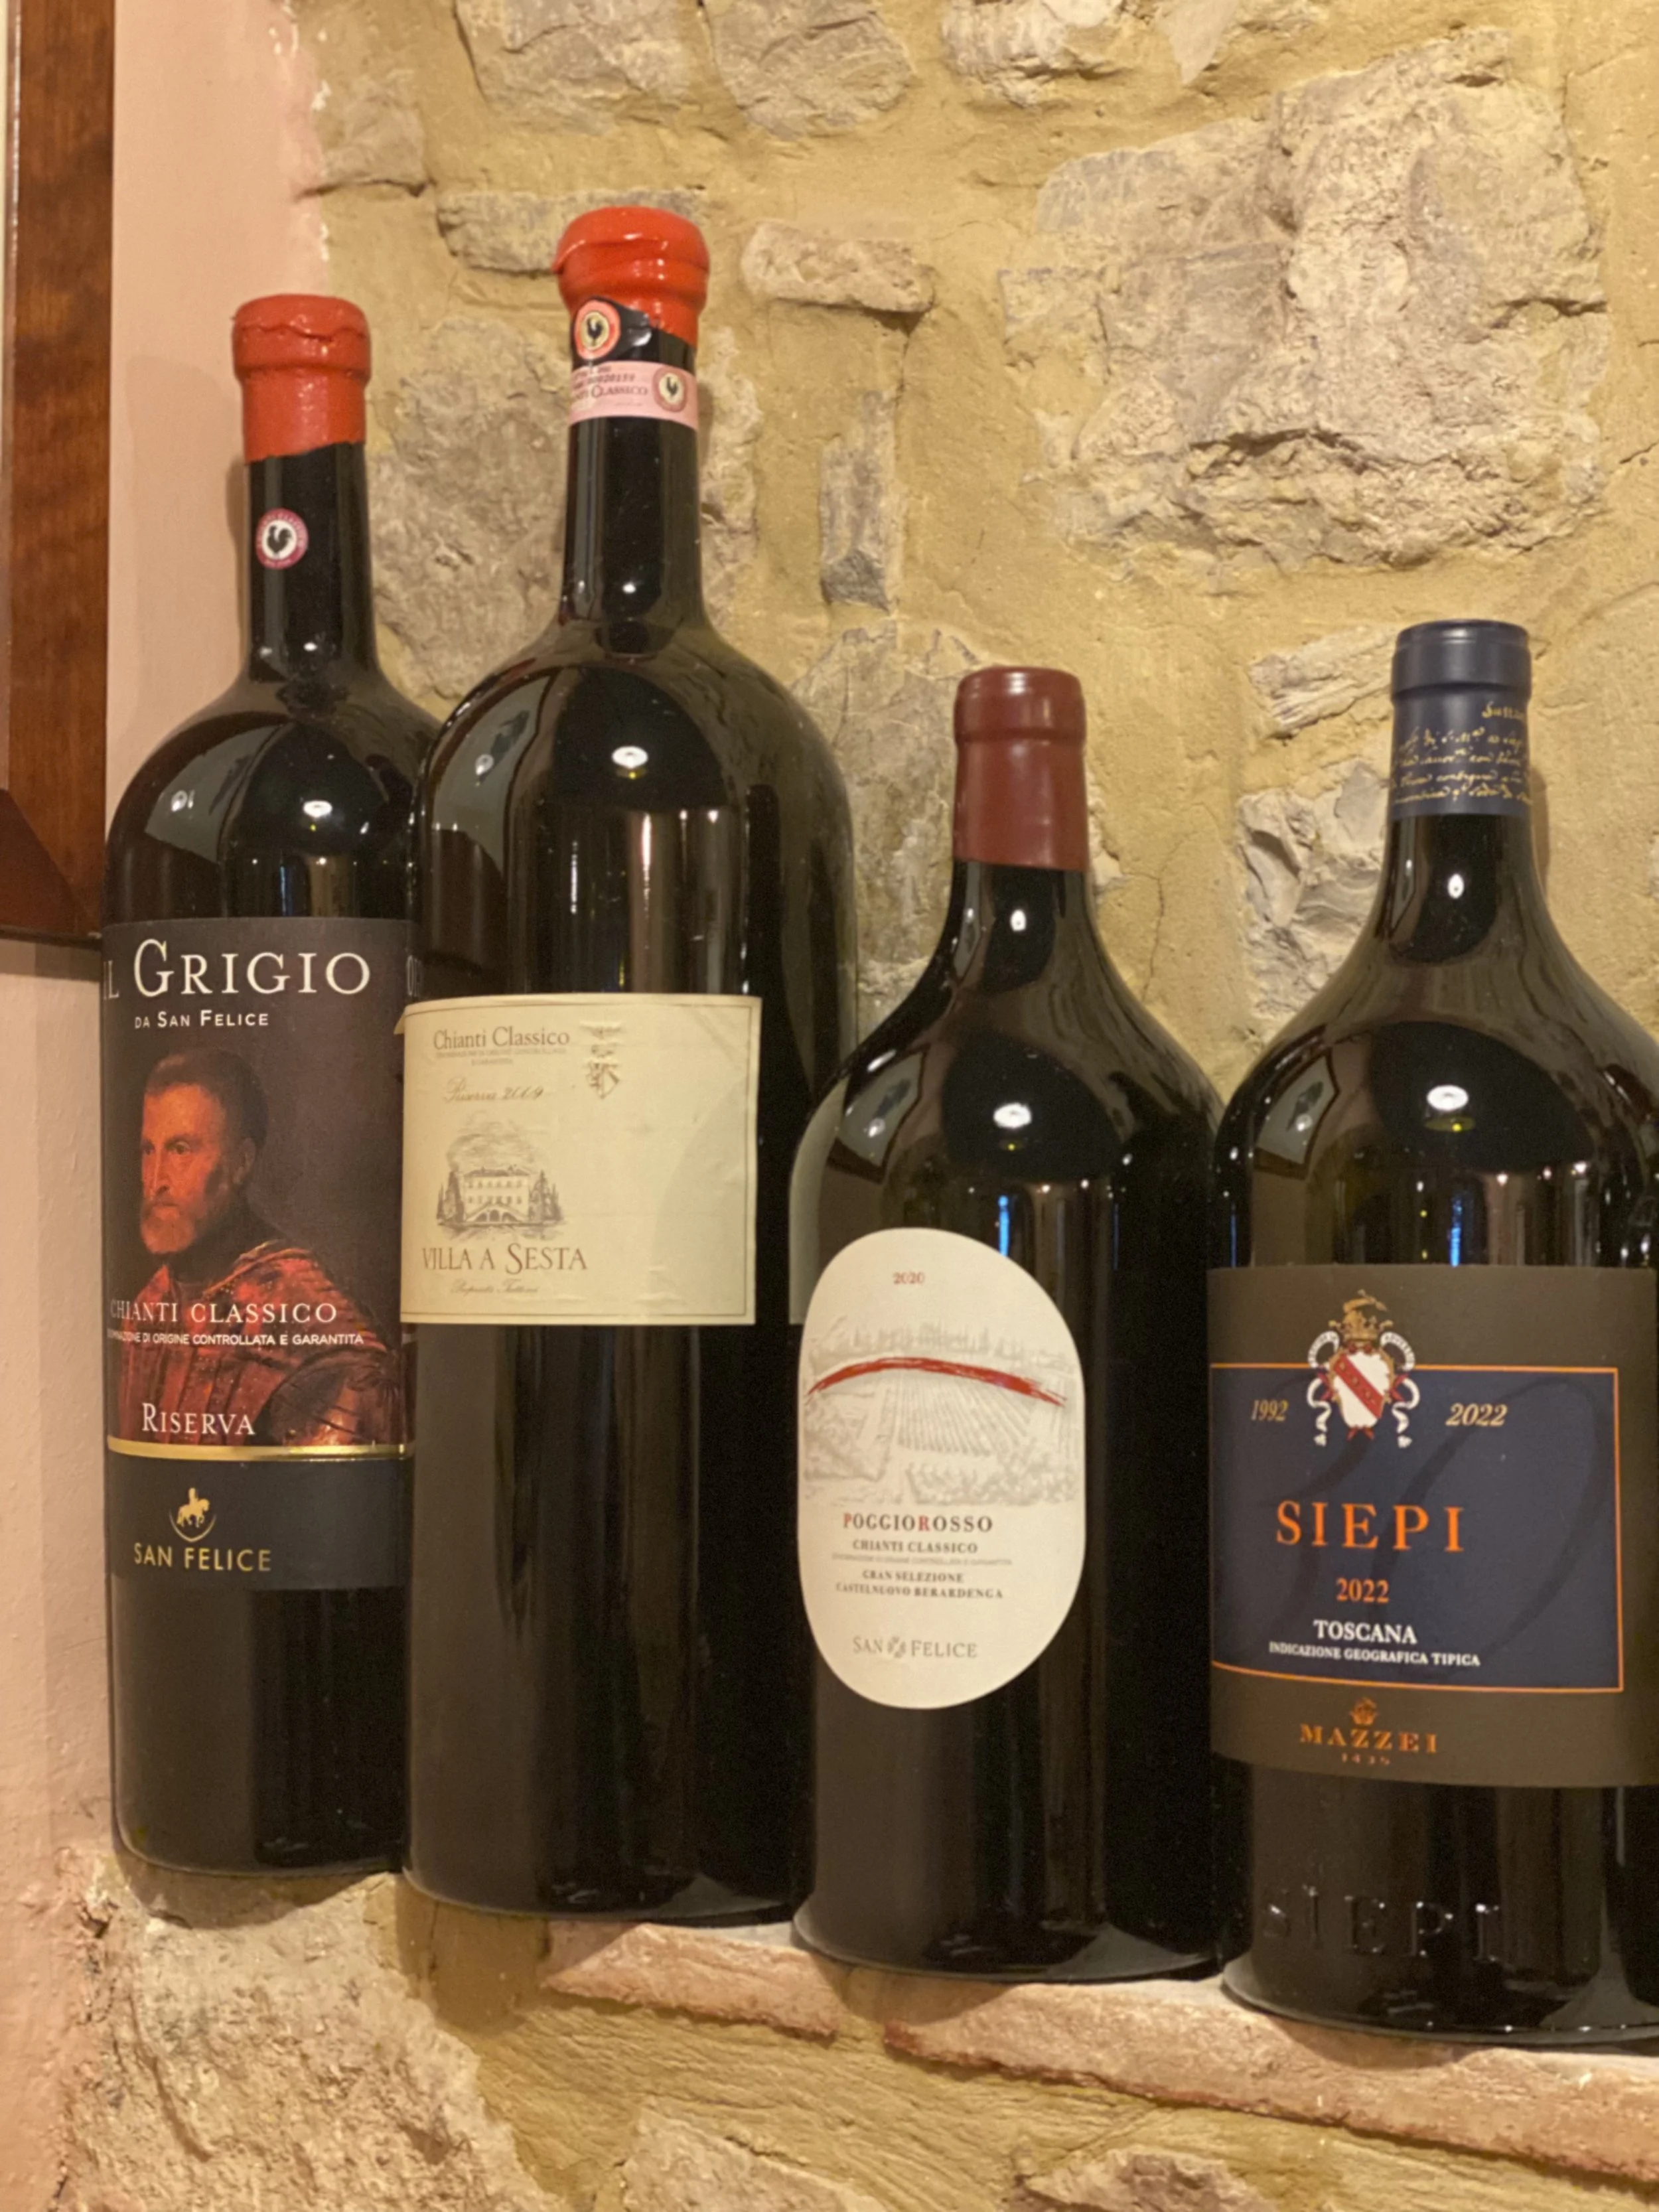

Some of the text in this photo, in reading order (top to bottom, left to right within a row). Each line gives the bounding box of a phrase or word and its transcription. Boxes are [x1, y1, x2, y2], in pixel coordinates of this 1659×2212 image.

[133, 938, 370, 997] GRIGIO
[135, 1009, 269, 1029] DA SAN FELICE
[433, 1025, 571, 1050] Chianti Classico
[422, 1242, 588, 1276] VILLA A SESTA
[110, 1299, 337, 1324] CHIANTI CLASSICO
[153, 1333, 190, 1345] ORIGINE
[192, 1333, 277, 1346] CONTROLLATA
[279, 1334, 289, 1346] E
[292, 1333, 364, 1346] GARANTITA
[141, 1402, 255, 1436] RISERVA
[1250, 1399, 1508, 1428] 1992 2022
[843, 1512, 993, 1533] POGGIOROSSO
[1275, 1499, 1465, 1553] SIEPI
[134, 1542, 271, 1572] SAN FELICE
[852, 1538, 979, 1554] CHIANTI CLASSICO
[895, 1571, 965, 1584] SELEZIONE
[1336, 1577, 1390, 1604] 2022
[914, 1586, 1004, 1599] BERARDENGA
[1313, 1619, 1418, 1645] TOSCANA
[852, 1635, 979, 1659] SAN FELICE
[1268, 1641, 1481, 1667] INDICAZIONE GEOGRAFICA TIPICA
[1299, 1723, 1439, 1754] MAZZEI
